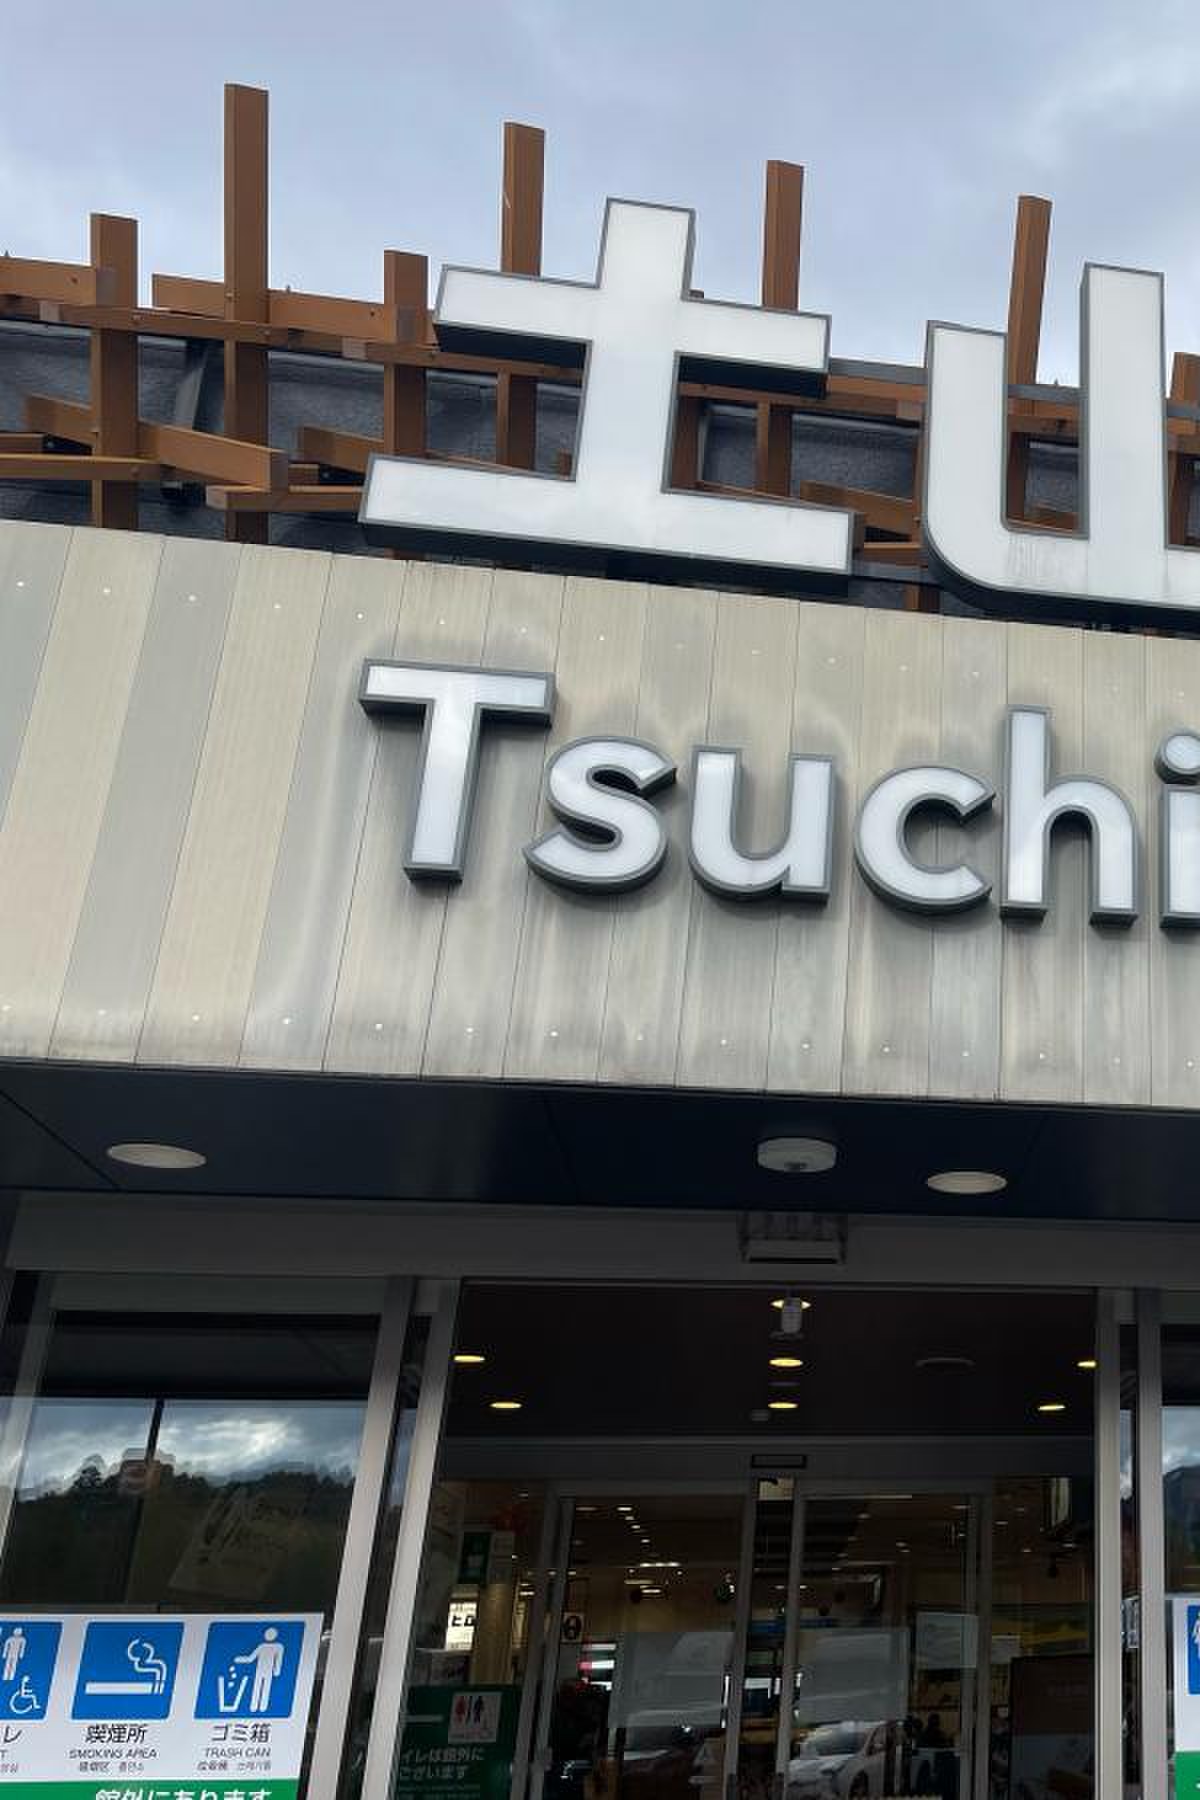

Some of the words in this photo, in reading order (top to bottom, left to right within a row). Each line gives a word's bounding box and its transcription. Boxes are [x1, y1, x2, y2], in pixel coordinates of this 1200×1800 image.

[86, 1723, 147, 1744] 喫煙所
[211, 1723, 271, 1743] ゴミ箱
[204, 1748, 243, 1759] TRASH
[245, 1747, 271, 1758] CAN
